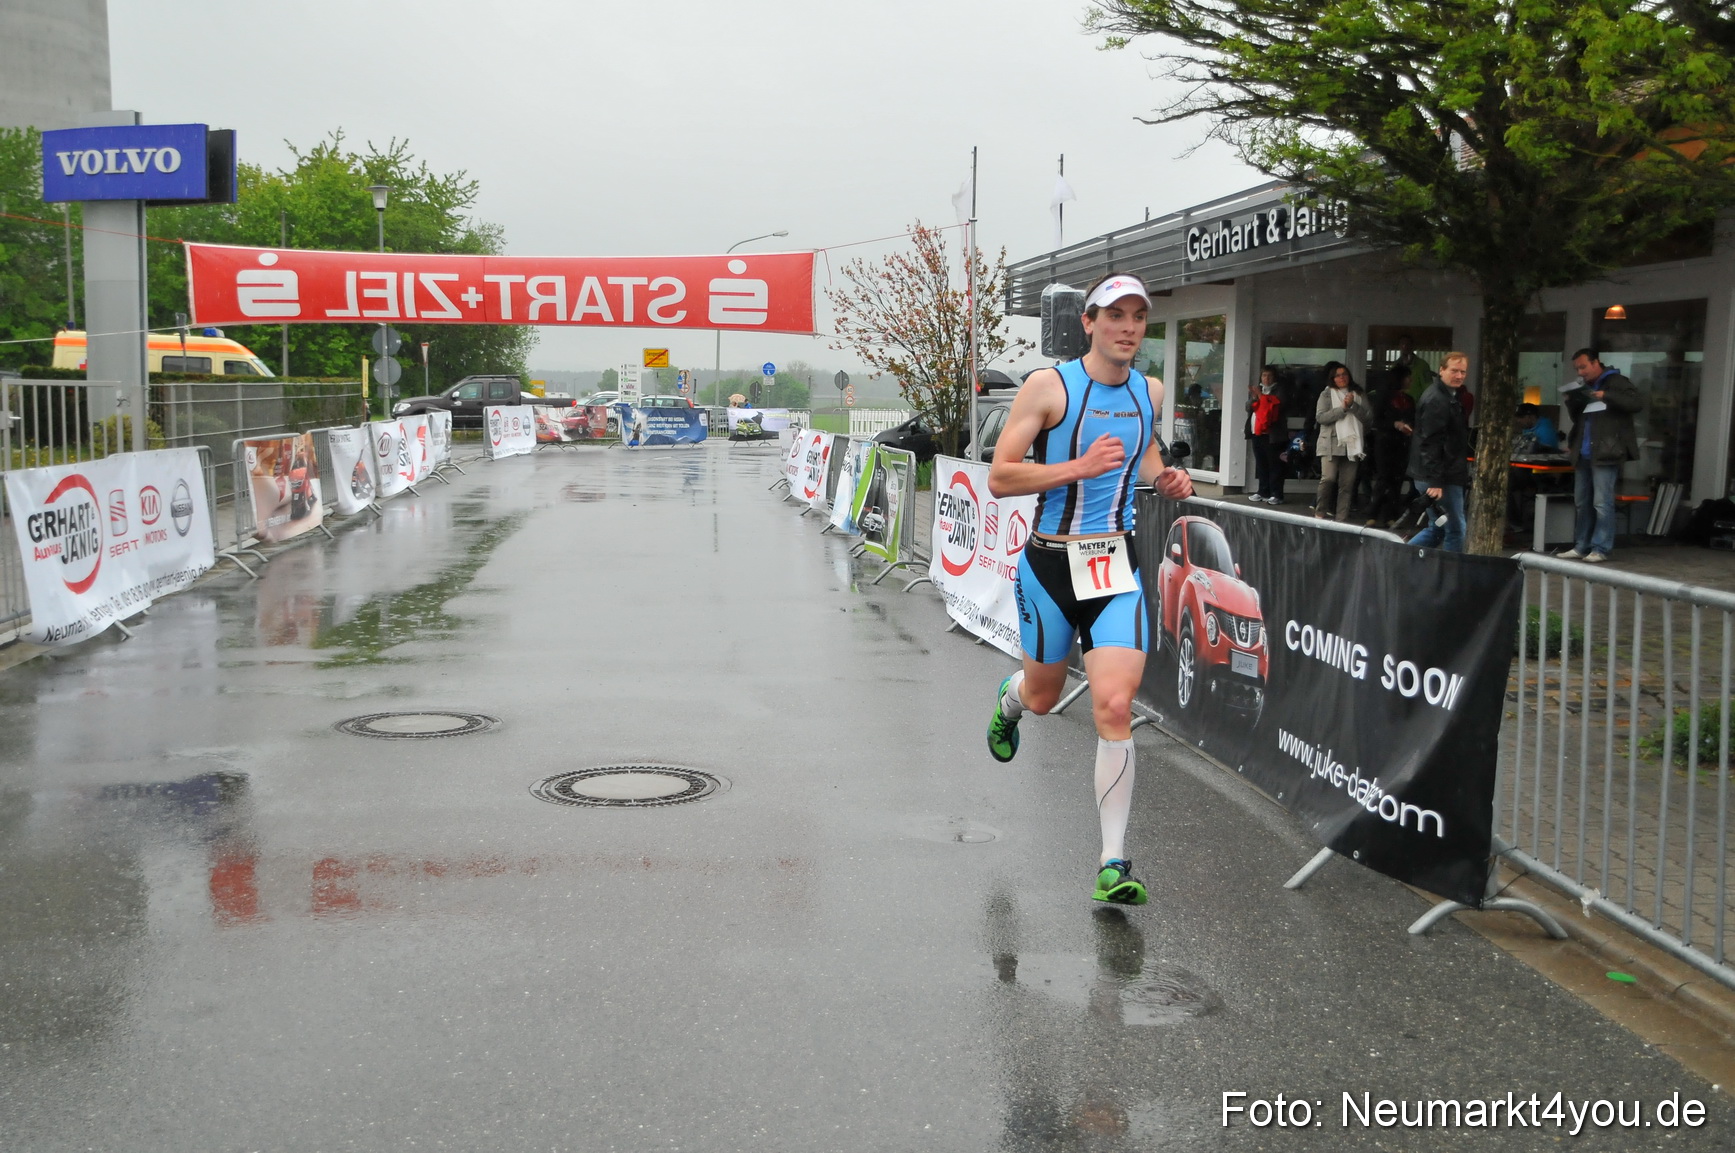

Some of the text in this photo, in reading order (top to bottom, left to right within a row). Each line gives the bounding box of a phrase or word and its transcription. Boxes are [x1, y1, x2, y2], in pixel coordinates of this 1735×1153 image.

[56, 147, 181, 176] VOLVO
[1187, 213, 1259, 262] Gerhart
[1266, 208, 1279, 244] &
[141, 495, 158, 516] KIA
[109, 539, 139, 558] SEAT
[1078, 541, 1106, 551] MEYER
[1080, 549, 1107, 557] WERBUNG
[1087, 556, 1112, 590] 17
[1285, 619, 1464, 710] COMING SOON
